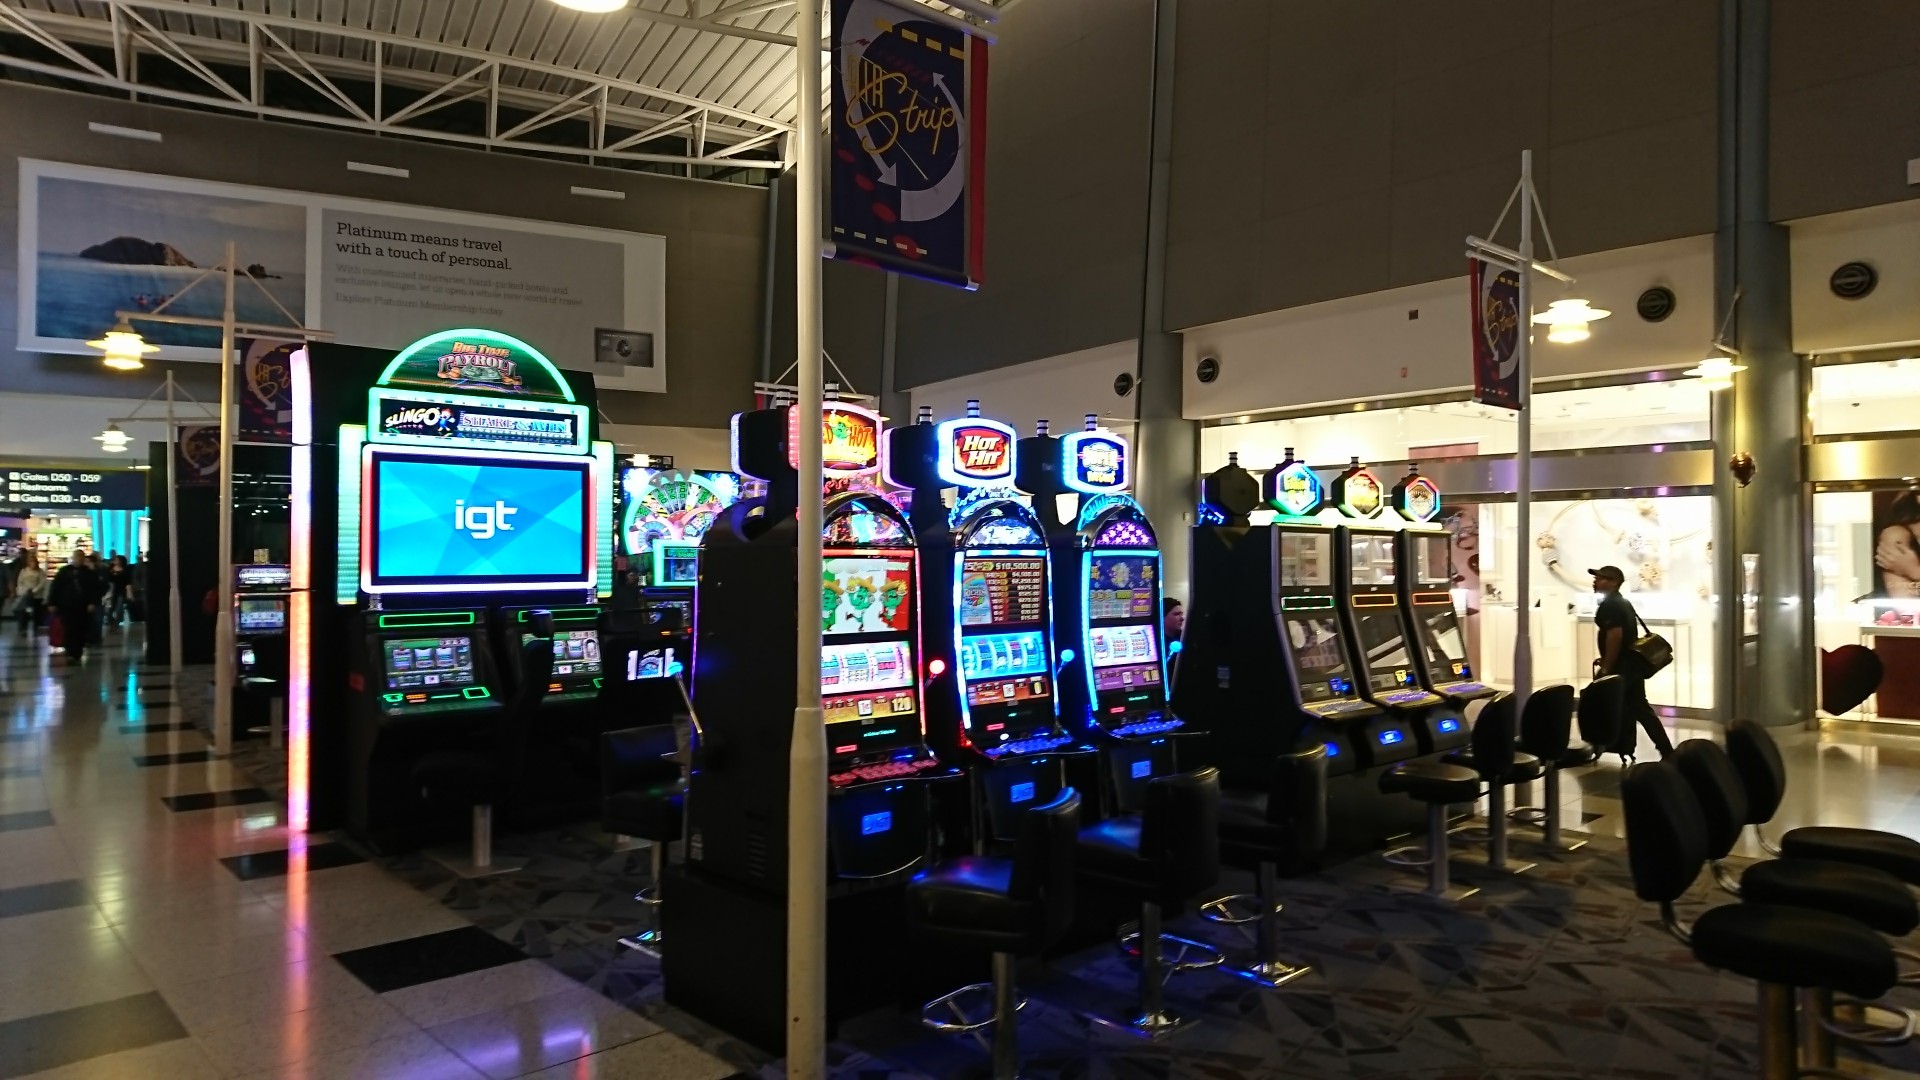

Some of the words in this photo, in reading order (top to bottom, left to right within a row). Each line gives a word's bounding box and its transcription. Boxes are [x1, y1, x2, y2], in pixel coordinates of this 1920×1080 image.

[846, 72, 956, 155] Strip
[337, 222, 407, 241] Platinum
[411, 233, 459, 247] means
[462, 238, 503, 252] travel
[336, 242, 371, 256] with
[375, 247, 384, 257] a
[388, 247, 429, 261] touch
[431, 251, 446, 263] of
[448, 255, 512, 270] personal.
[336, 276, 380, 288] exclusive
[504, 292, 521, 301] new
[522, 292, 549, 304] world
[337, 264, 361, 275] With
[552, 285, 569, 296] and
[336, 292, 372, 305] Explore
[374, 295, 418, 309] Platinum
[420, 299, 478, 315] Membership
[438, 353, 520, 382] PAYROLL
[463, 414, 513, 429] SHARE
[517, 419, 531, 431] &
[532, 419, 567, 433] WIN
[963, 435, 1002, 452] HOT
[966, 450, 1002, 468] HIT
[21, 472, 49, 481] Gates
[50, 473, 72, 481] D50
[80, 474, 101, 482] D59
[21, 482, 69, 491] Restrooms
[21, 493, 49, 502] Gates
[80, 495, 102, 503] D43
[455, 499, 518, 539] igt
